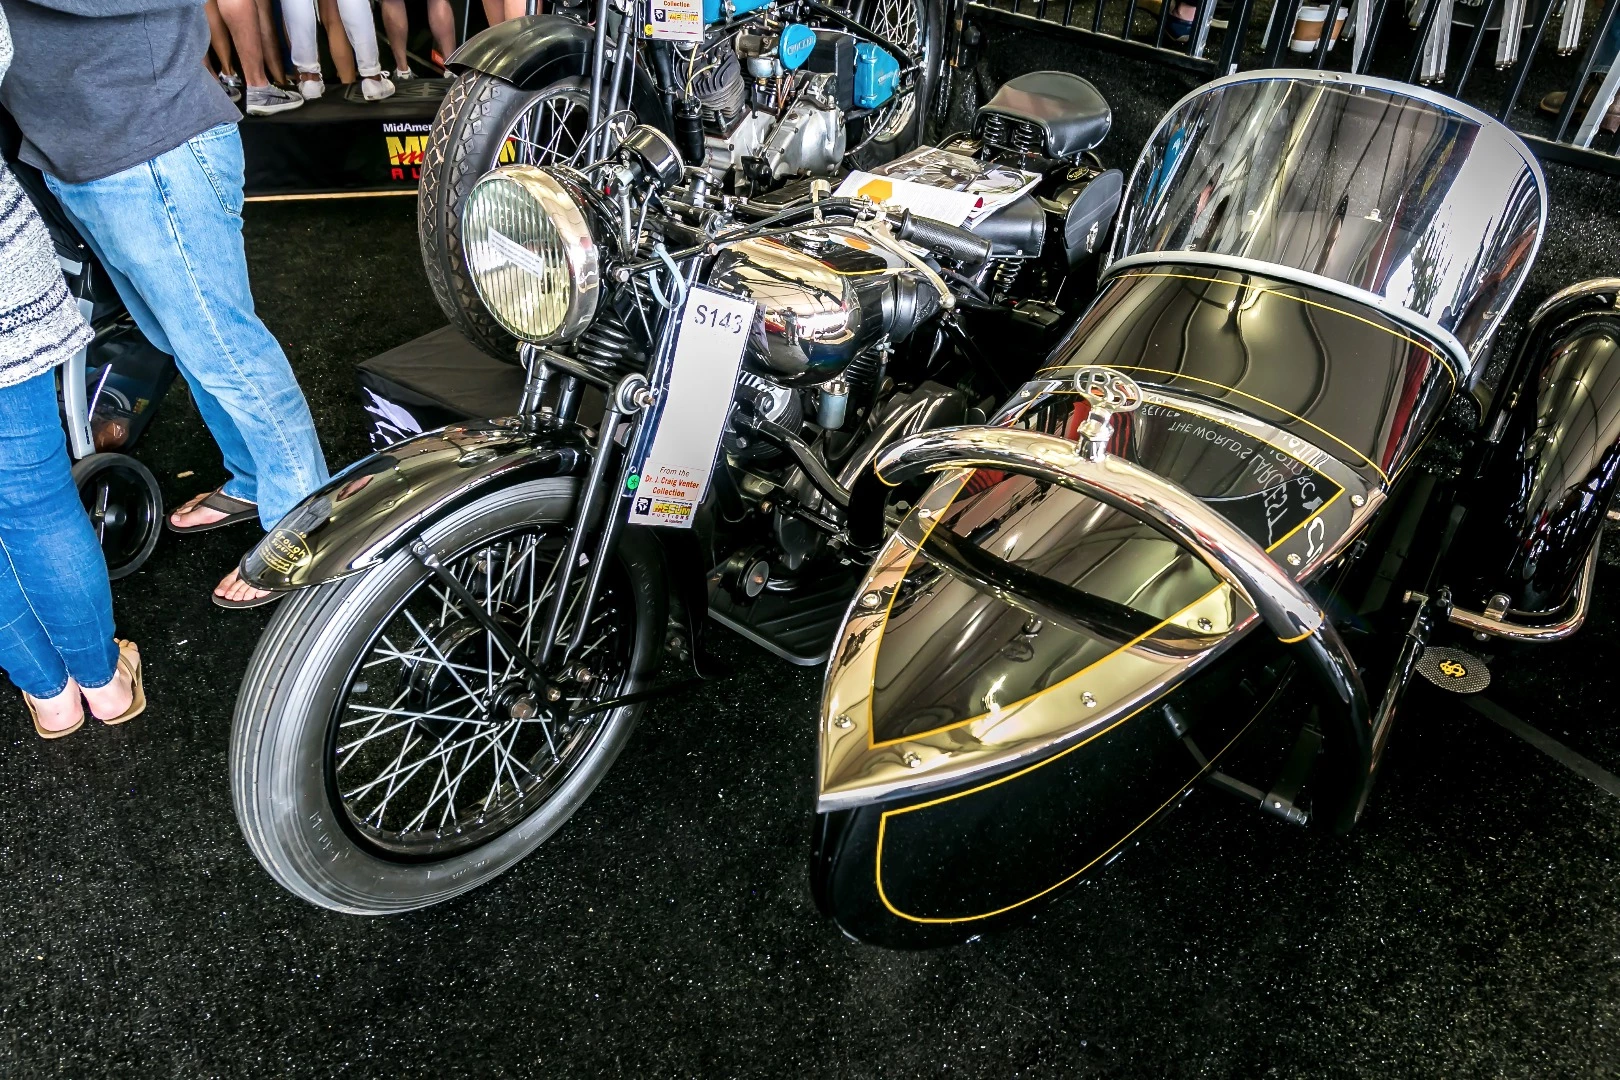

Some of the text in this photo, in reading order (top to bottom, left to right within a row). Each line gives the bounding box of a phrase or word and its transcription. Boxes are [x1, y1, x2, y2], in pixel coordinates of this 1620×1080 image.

[694, 304, 743, 334] S143
[659, 467, 677, 475] From
[661, 477, 677, 487] Craig
[678, 479, 699, 488] Venter
[653, 487, 685, 497] Collection
[271, 538, 298, 561] Superior
[274, 531, 306, 558] Brough
